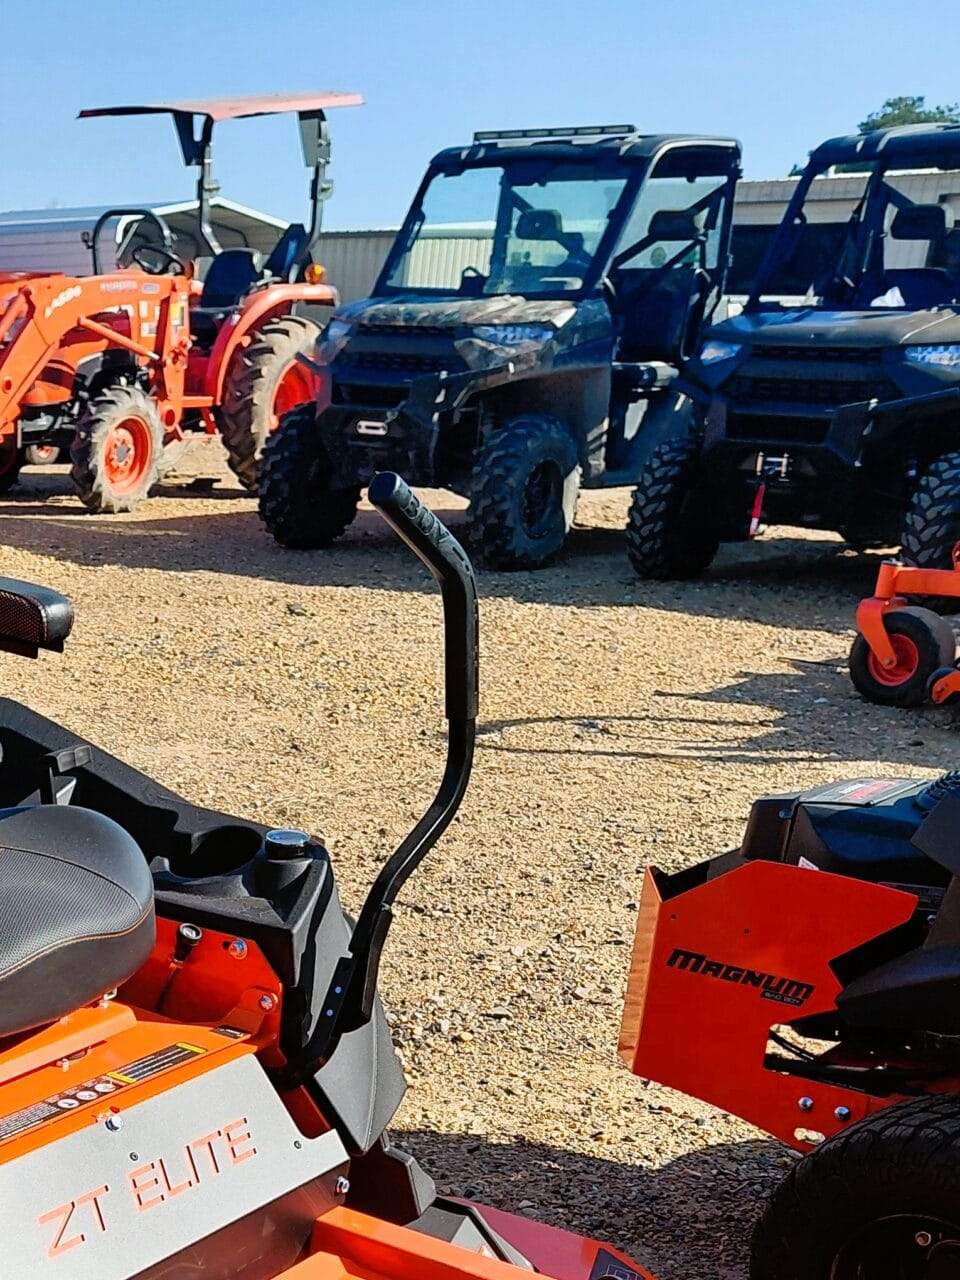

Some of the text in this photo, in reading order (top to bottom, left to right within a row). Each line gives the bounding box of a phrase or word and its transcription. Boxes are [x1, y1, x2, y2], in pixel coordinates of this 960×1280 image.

[666, 948, 816, 1000] MAGNUM
[38, 1185, 110, 1258] ZT
[127, 1117, 258, 1212] ELITE
